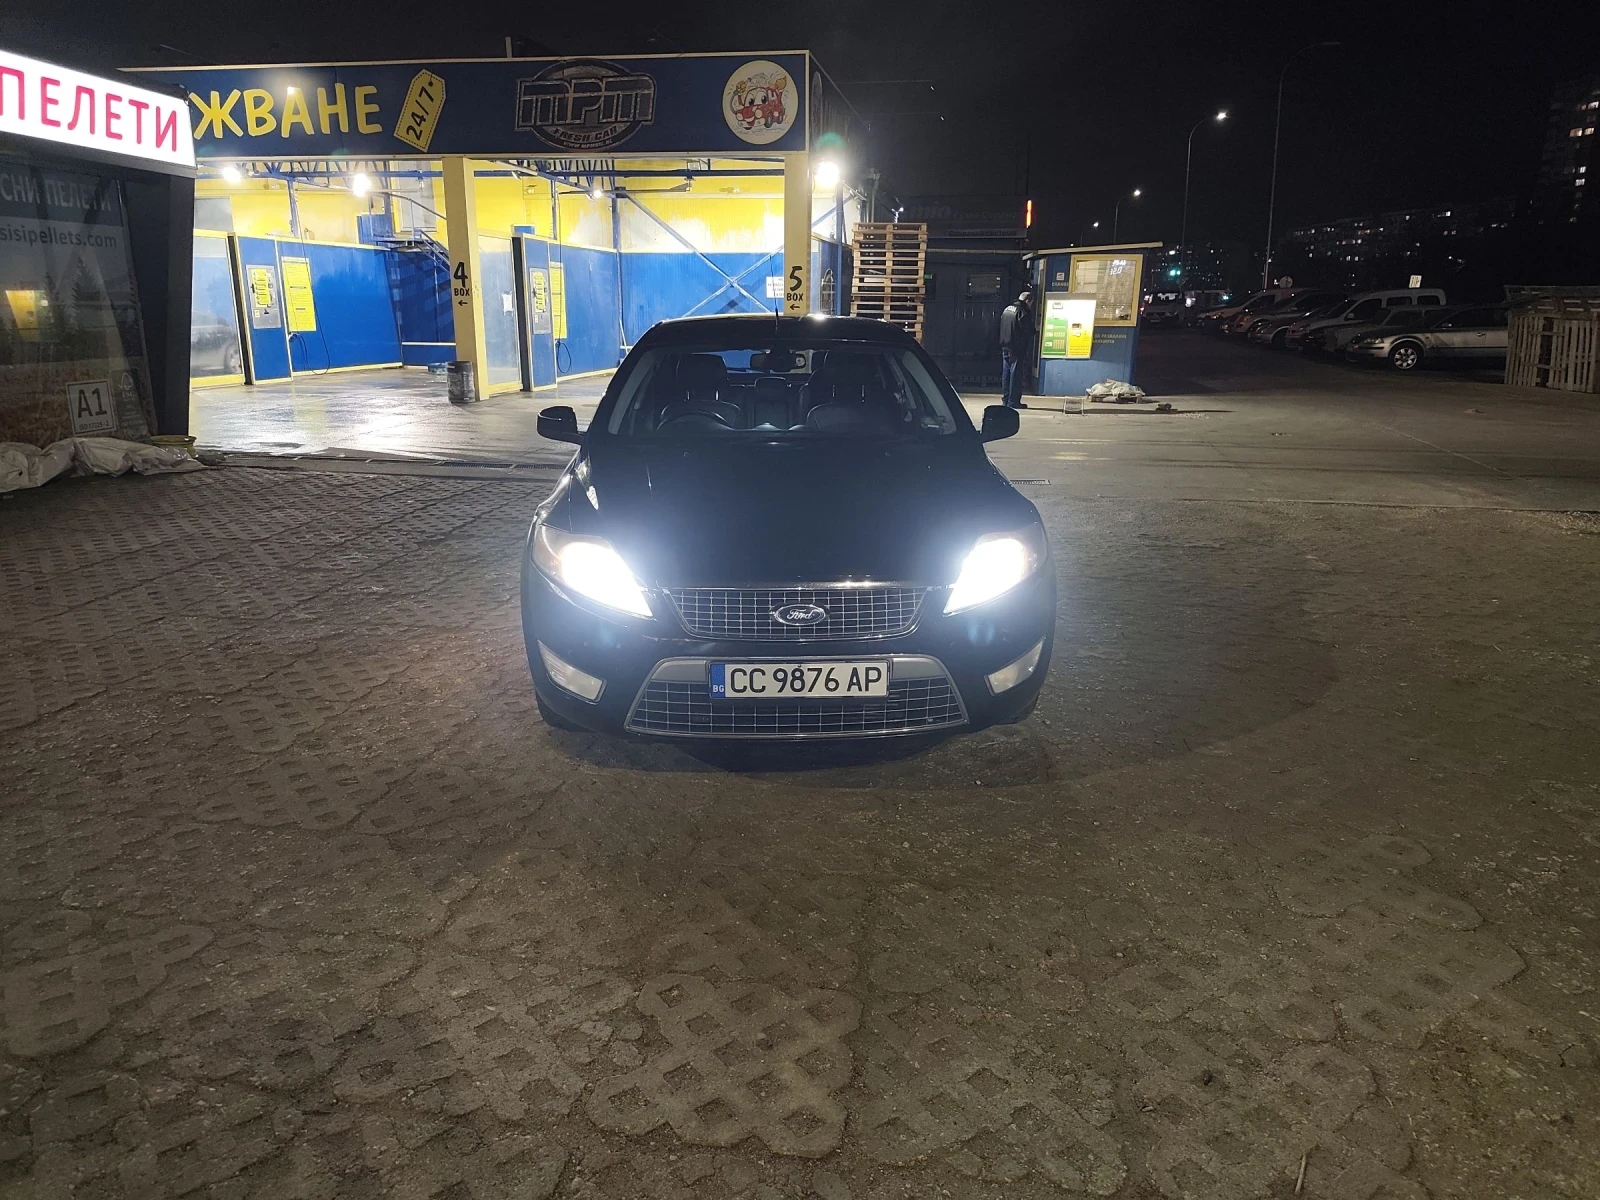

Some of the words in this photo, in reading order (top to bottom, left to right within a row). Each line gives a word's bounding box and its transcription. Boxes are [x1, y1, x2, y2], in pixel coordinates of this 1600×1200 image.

[0, 66, 177, 152] ПЕЛЕТИ
[188, 83, 383, 140] ЖВАНЕ
[406, 85, 435, 141] 24/7
[553, 128, 591, 142] FRESH
[594, 125, 618, 140] CAR
[453, 261, 468, 288] 4
[789, 265, 803, 291] 5
[453, 287, 470, 297] BOX
[786, 292, 804, 302] BOX
[77, 387, 108, 419] A1
[786, 609, 813, 620] Ford
[712, 684, 725, 693] BG
[730, 667, 766, 693] CC
[772, 667, 840, 693] 9876
[846, 666, 882, 692] AP
